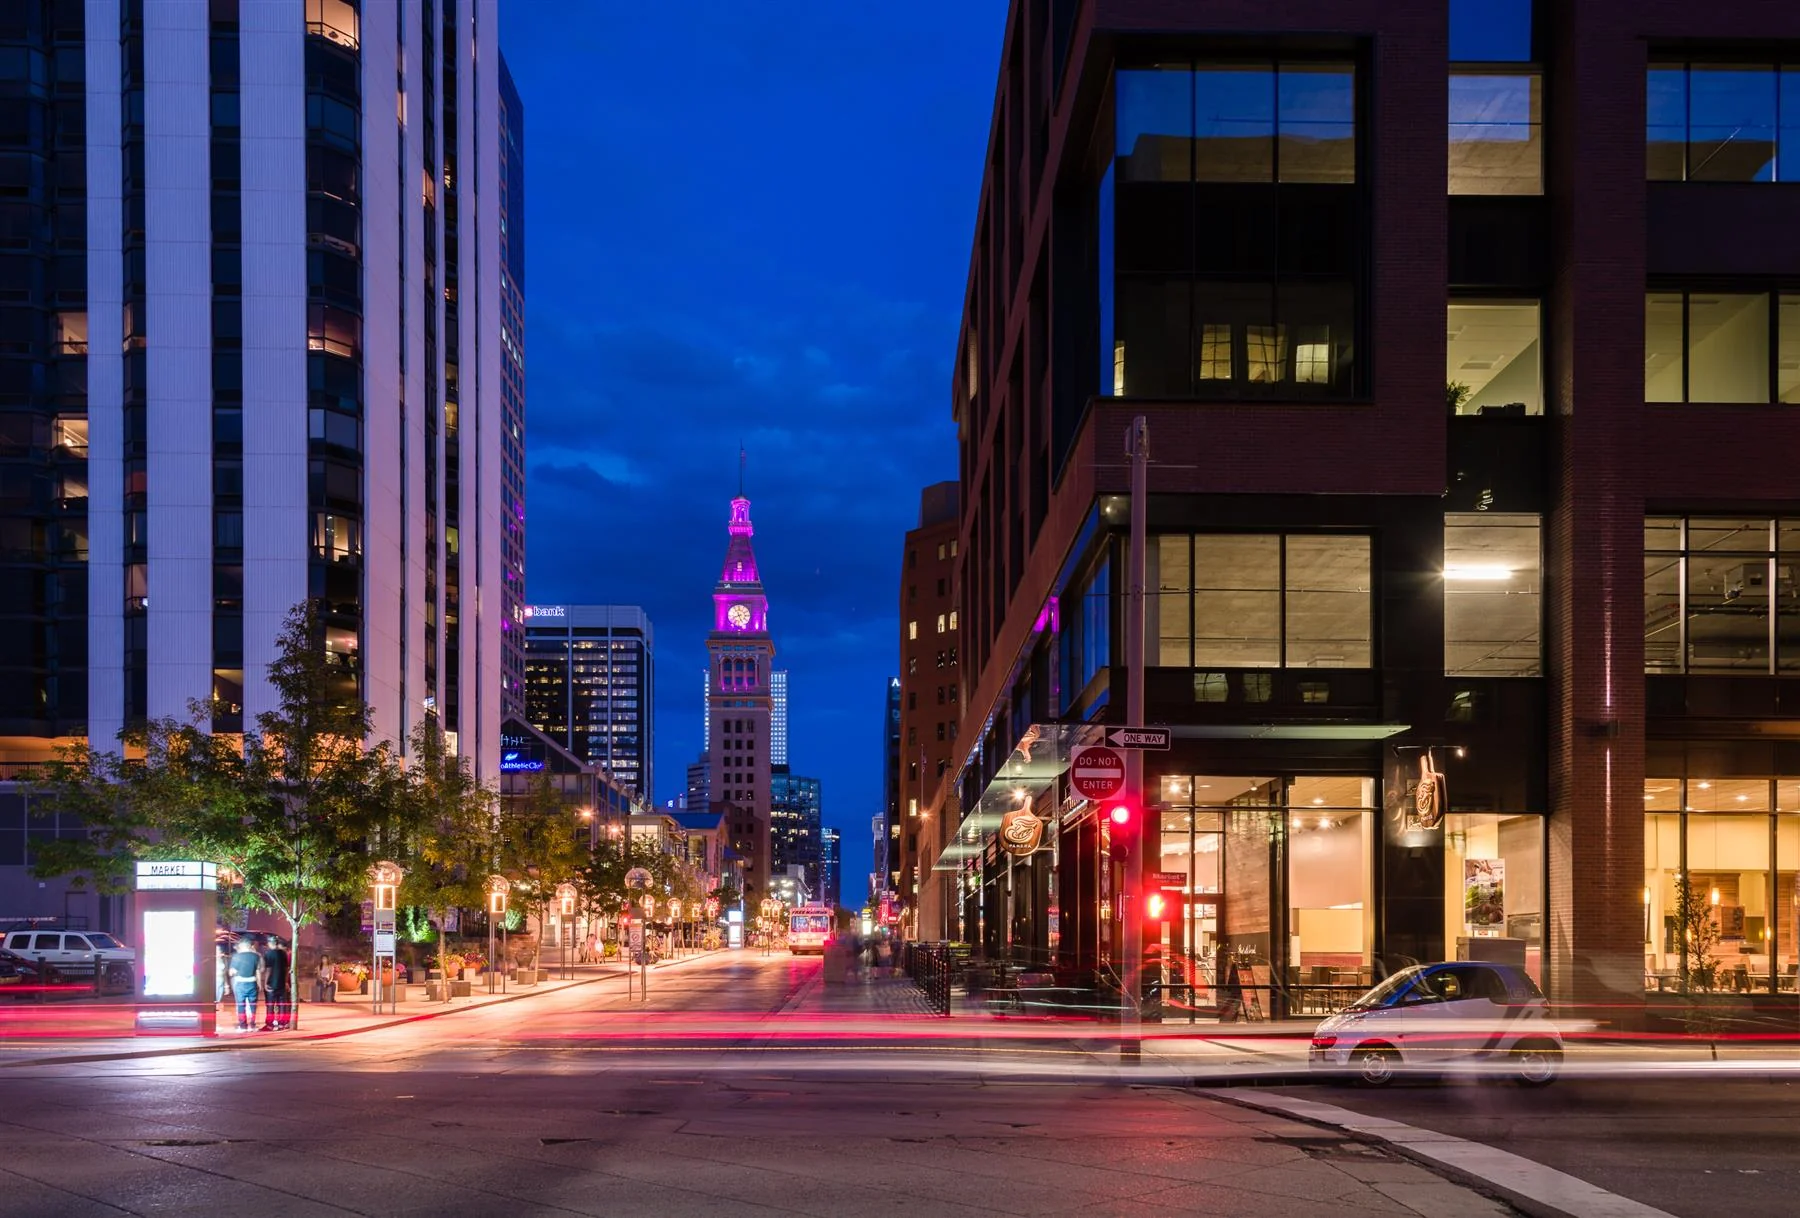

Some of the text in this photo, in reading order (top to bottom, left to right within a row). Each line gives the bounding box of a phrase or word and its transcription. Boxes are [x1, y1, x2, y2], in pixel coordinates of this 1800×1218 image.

[534, 606, 565, 617] bank
[1124, 734, 1163, 744] ONE WAY
[1080, 757, 1117, 767] DO NOT
[1083, 781, 1113, 790] ENTER
[151, 865, 186, 875] MARKET
